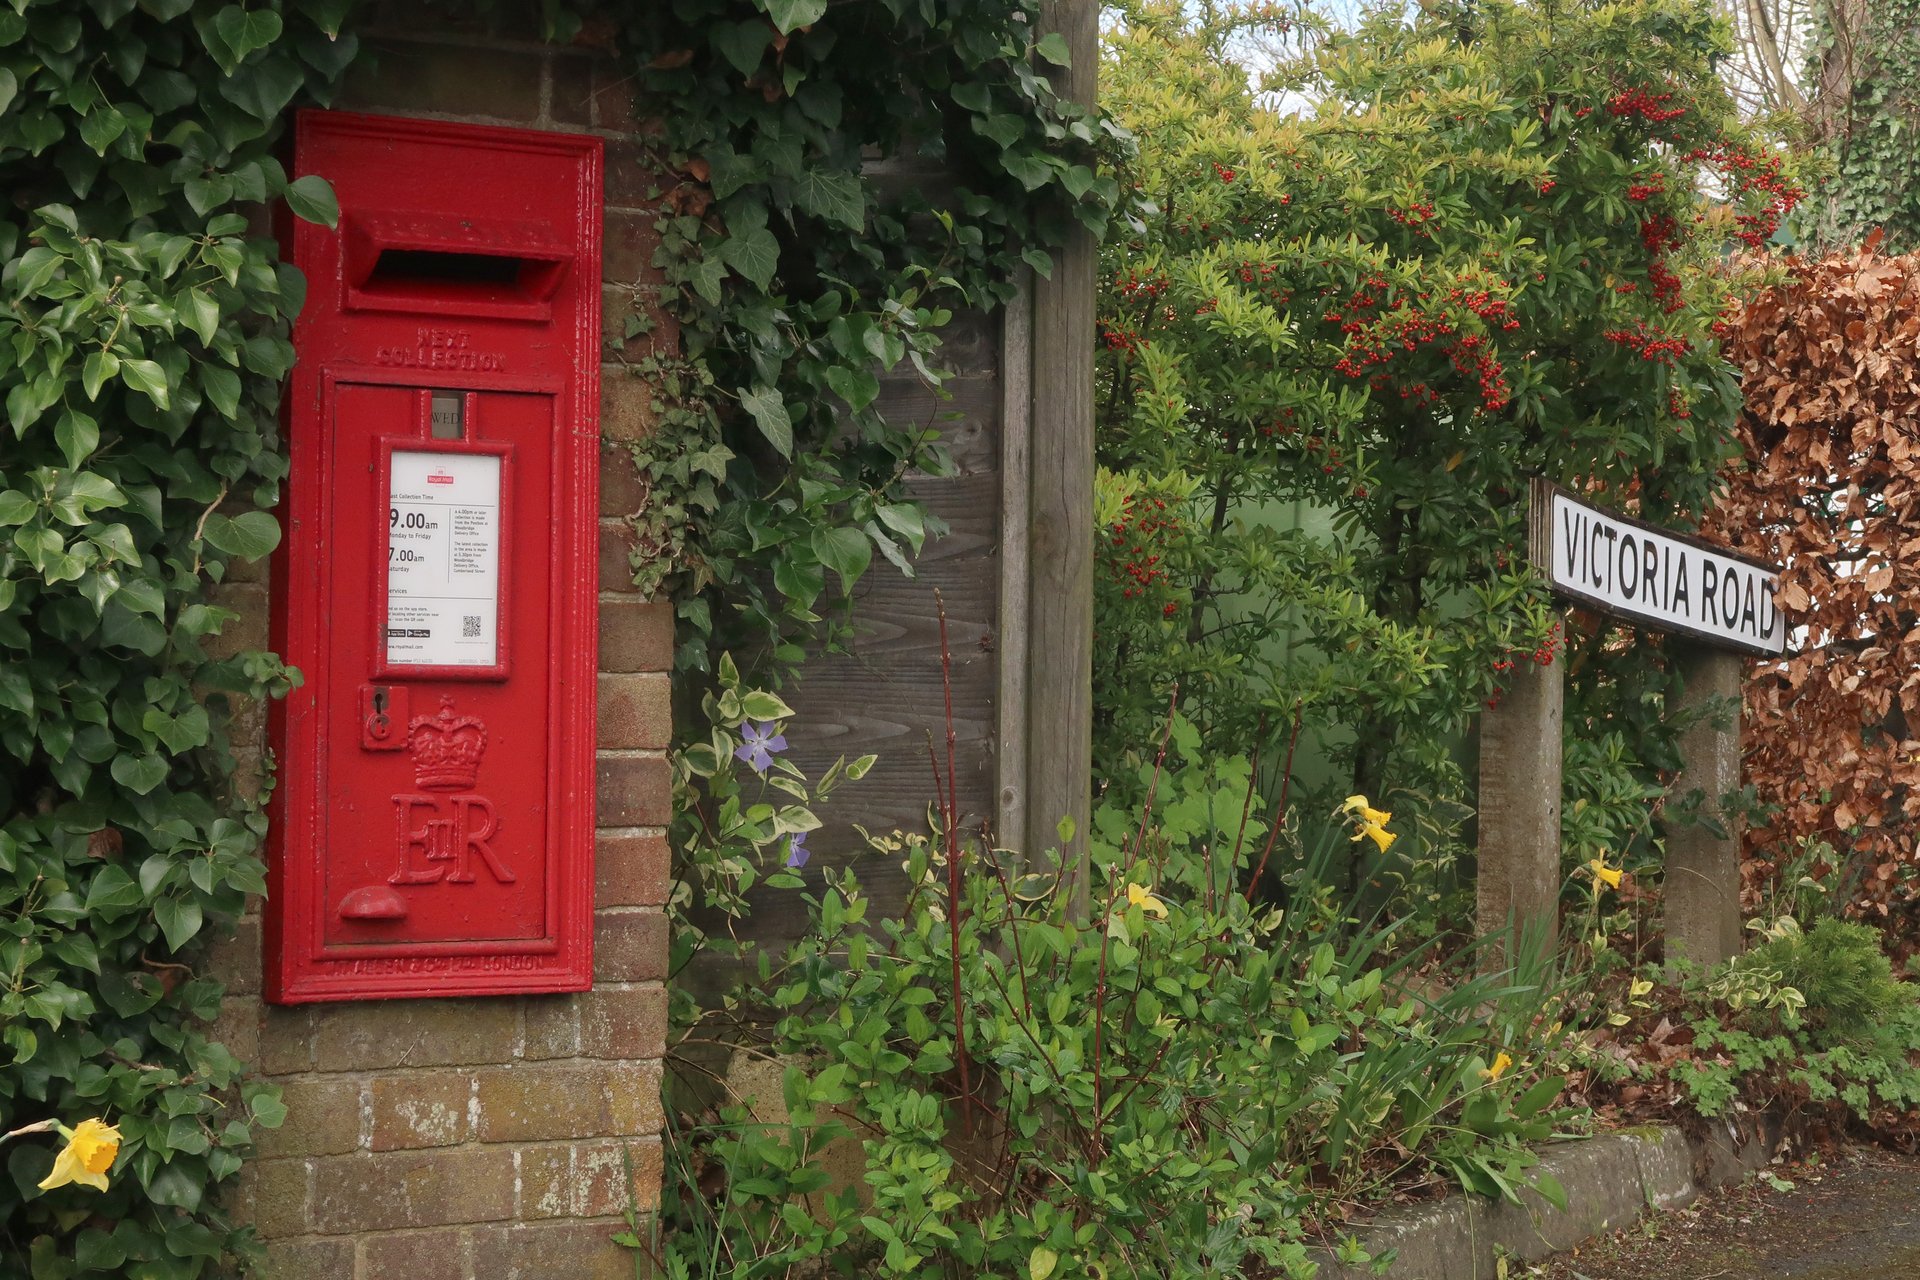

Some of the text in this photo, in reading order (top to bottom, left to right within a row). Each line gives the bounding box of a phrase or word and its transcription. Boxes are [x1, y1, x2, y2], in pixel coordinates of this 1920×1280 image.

[417, 328, 471, 348] NEXT
[376, 346, 506, 372] COLLECTION
[432, 412, 460, 425] WED
[390, 508, 438, 530] 9.00am
[1563, 506, 1776, 640] VICTORIA ROAD
[483, 955, 544, 971] LONDON
